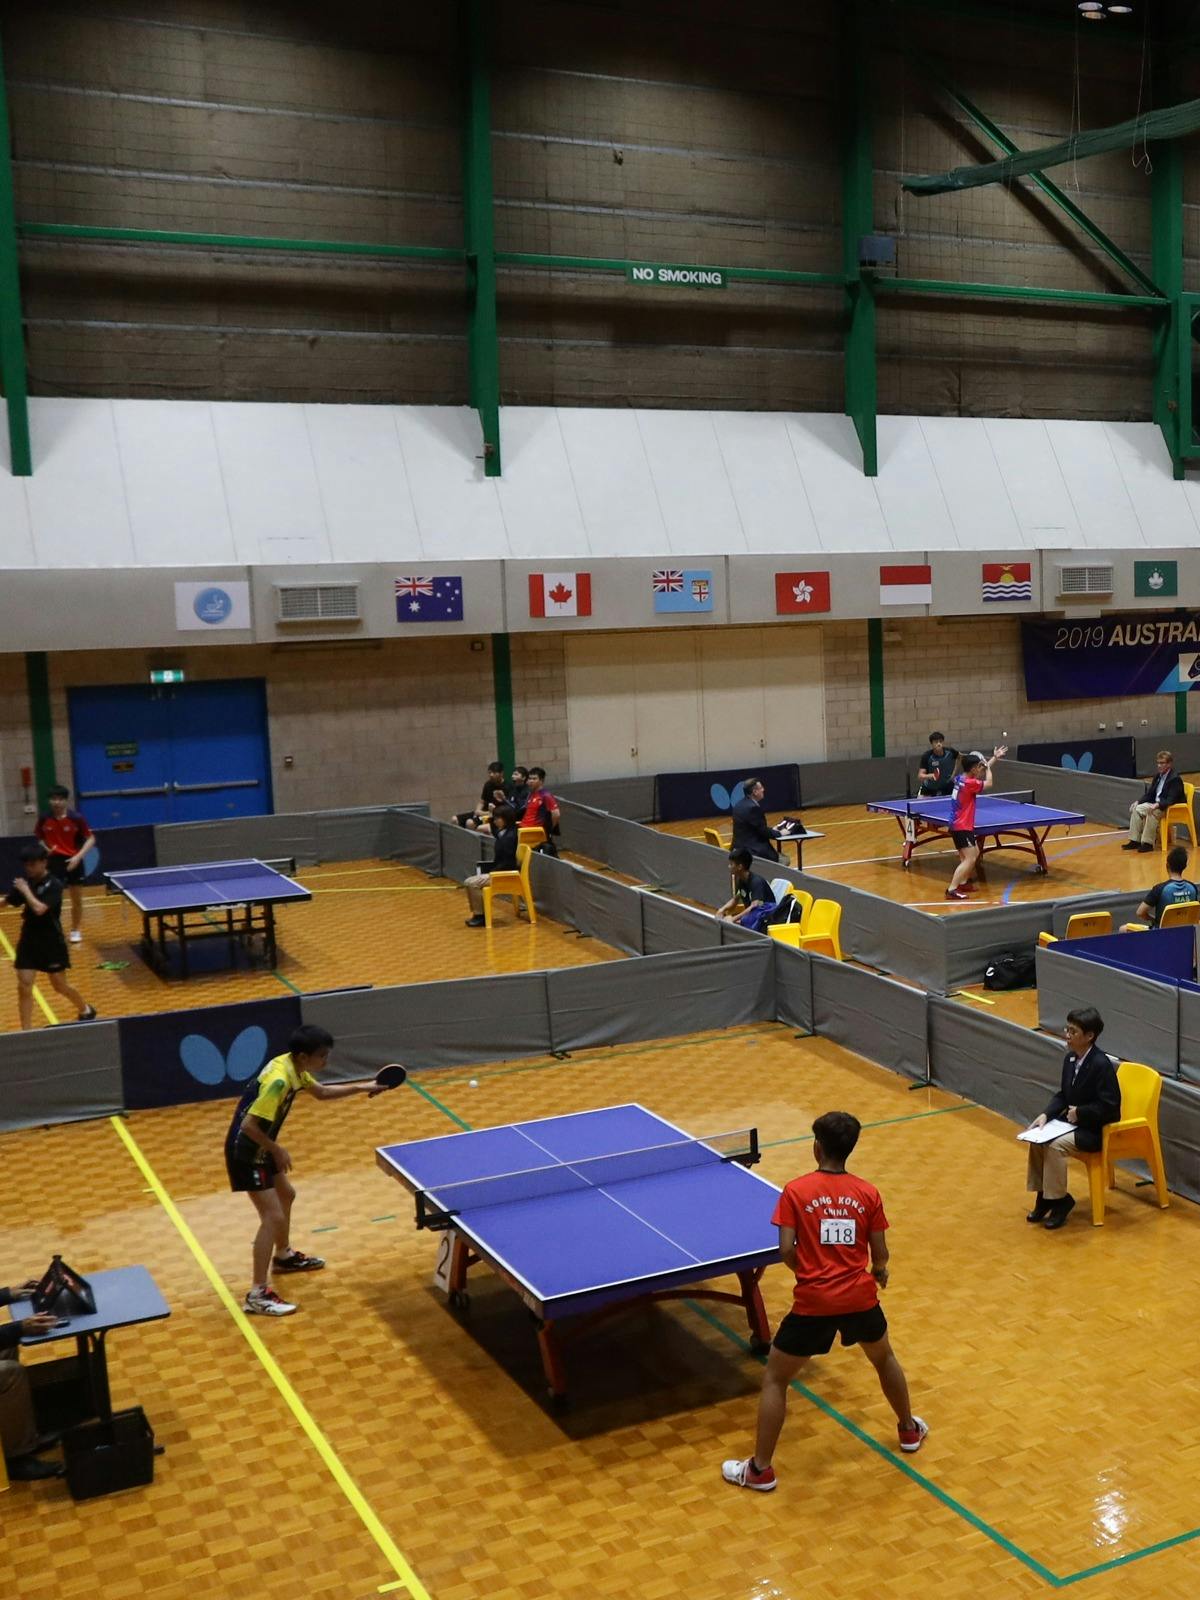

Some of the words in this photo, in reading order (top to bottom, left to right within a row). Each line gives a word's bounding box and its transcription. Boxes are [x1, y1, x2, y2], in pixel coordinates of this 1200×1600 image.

[632, 267, 654, 280] NO
[658, 269, 722, 285] SMOKING
[1054, 626, 1104, 649] 2019
[907, 821, 913, 836] 4
[805, 1196, 832, 1214] HONG
[838, 1196, 865, 1214] KONG
[823, 1207, 849, 1216] CHINA
[822, 1228, 853, 1243] 118
[436, 1236, 450, 1281] 2
